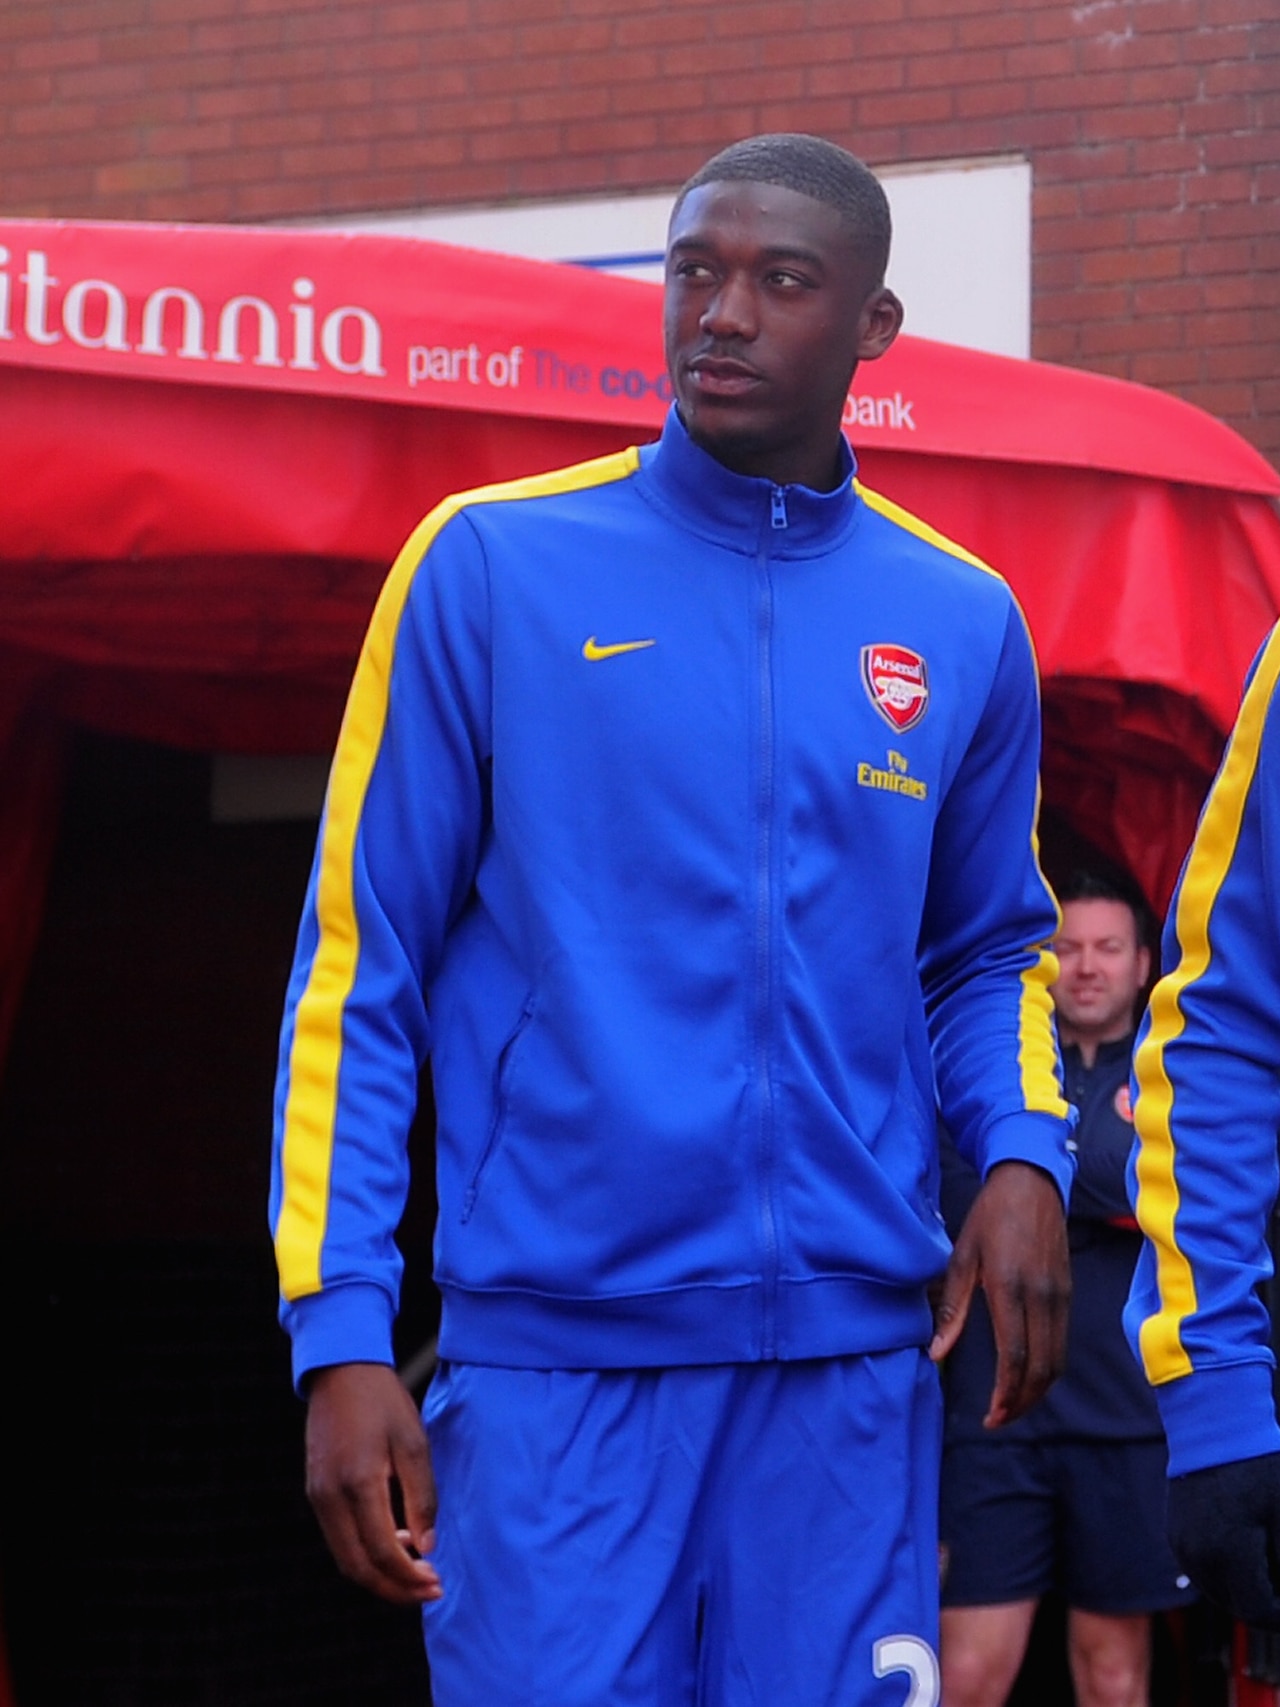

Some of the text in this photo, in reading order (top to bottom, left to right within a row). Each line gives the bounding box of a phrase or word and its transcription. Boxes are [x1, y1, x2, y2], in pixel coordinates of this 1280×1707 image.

[408, 344, 480, 388] part
[487, 345, 522, 388] of
[531, 348, 591, 394] The
[857, 762, 928, 801] Emirates
